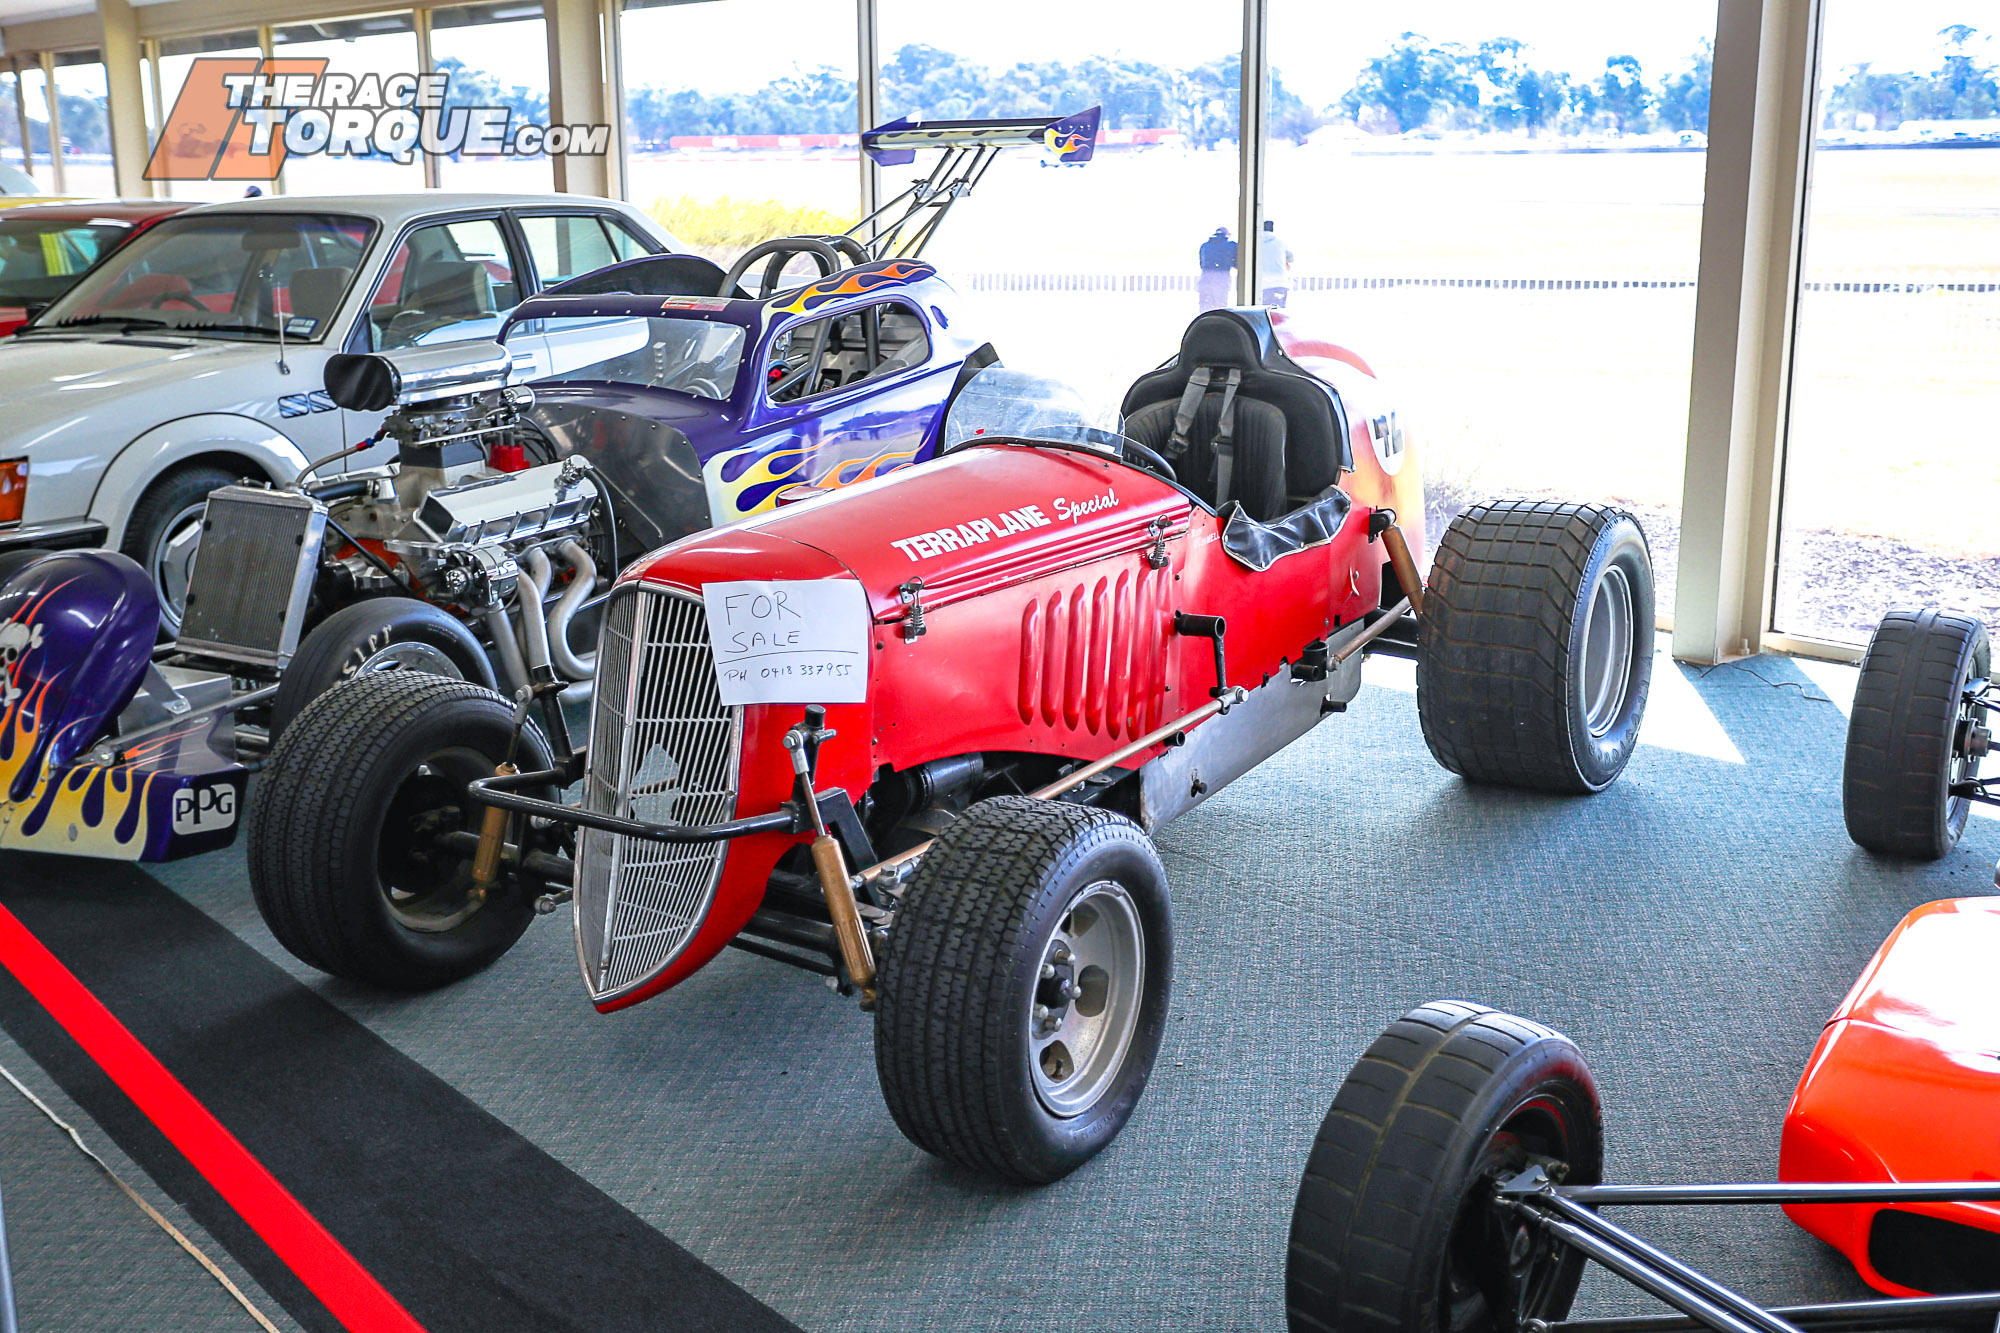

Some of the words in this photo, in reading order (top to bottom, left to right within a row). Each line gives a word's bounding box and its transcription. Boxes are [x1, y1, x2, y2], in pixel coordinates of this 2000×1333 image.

[890, 505, 1052, 562] TERRAPLANE
[1053, 488, 1120, 524] Special
[725, 590, 802, 626] FOR
[724, 630, 801, 654] SALE
[723, 669, 747, 682] PH
[760, 665, 793, 679] 0418
[800, 662, 853, 677] 337955
[175, 782, 233, 825] PPG
